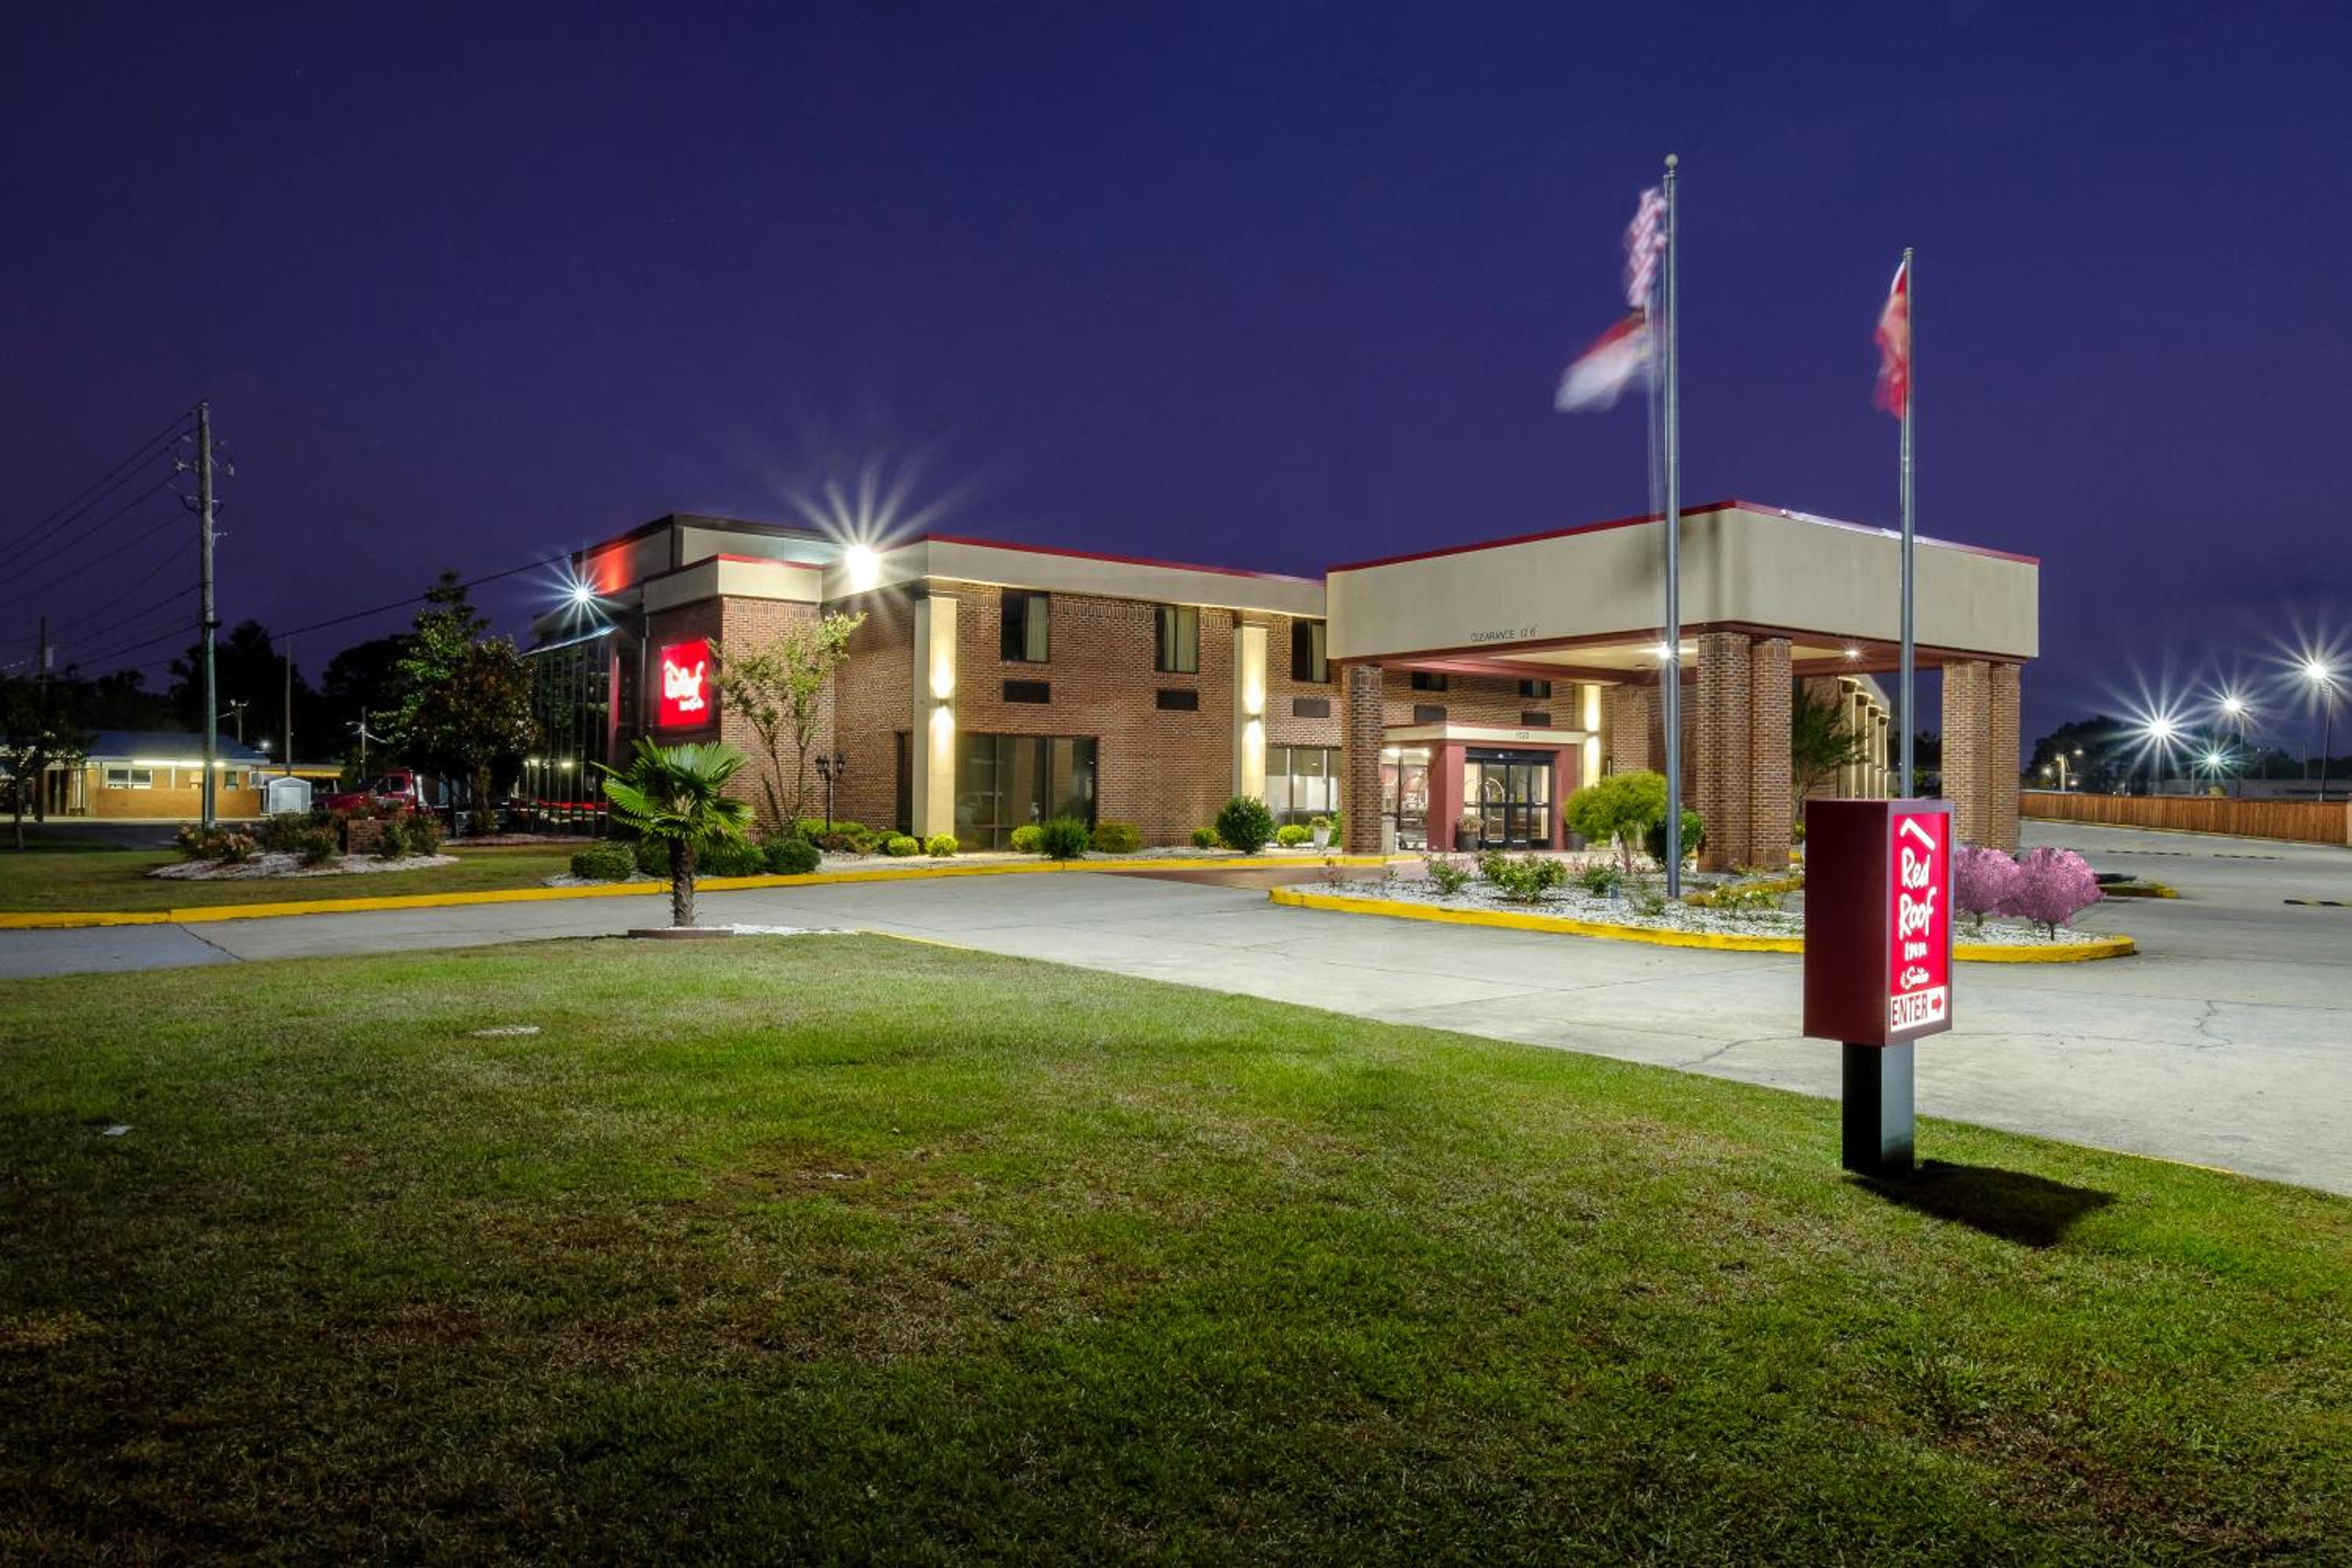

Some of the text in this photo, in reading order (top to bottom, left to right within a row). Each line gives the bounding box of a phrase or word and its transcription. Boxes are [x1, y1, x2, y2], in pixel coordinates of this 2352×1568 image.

[1469, 629, 1515, 641] CLEARANCE
[1901, 847, 1931, 889] Red
[1899, 887, 1937, 940] Roof
[1892, 993, 1928, 1026] ENTER
